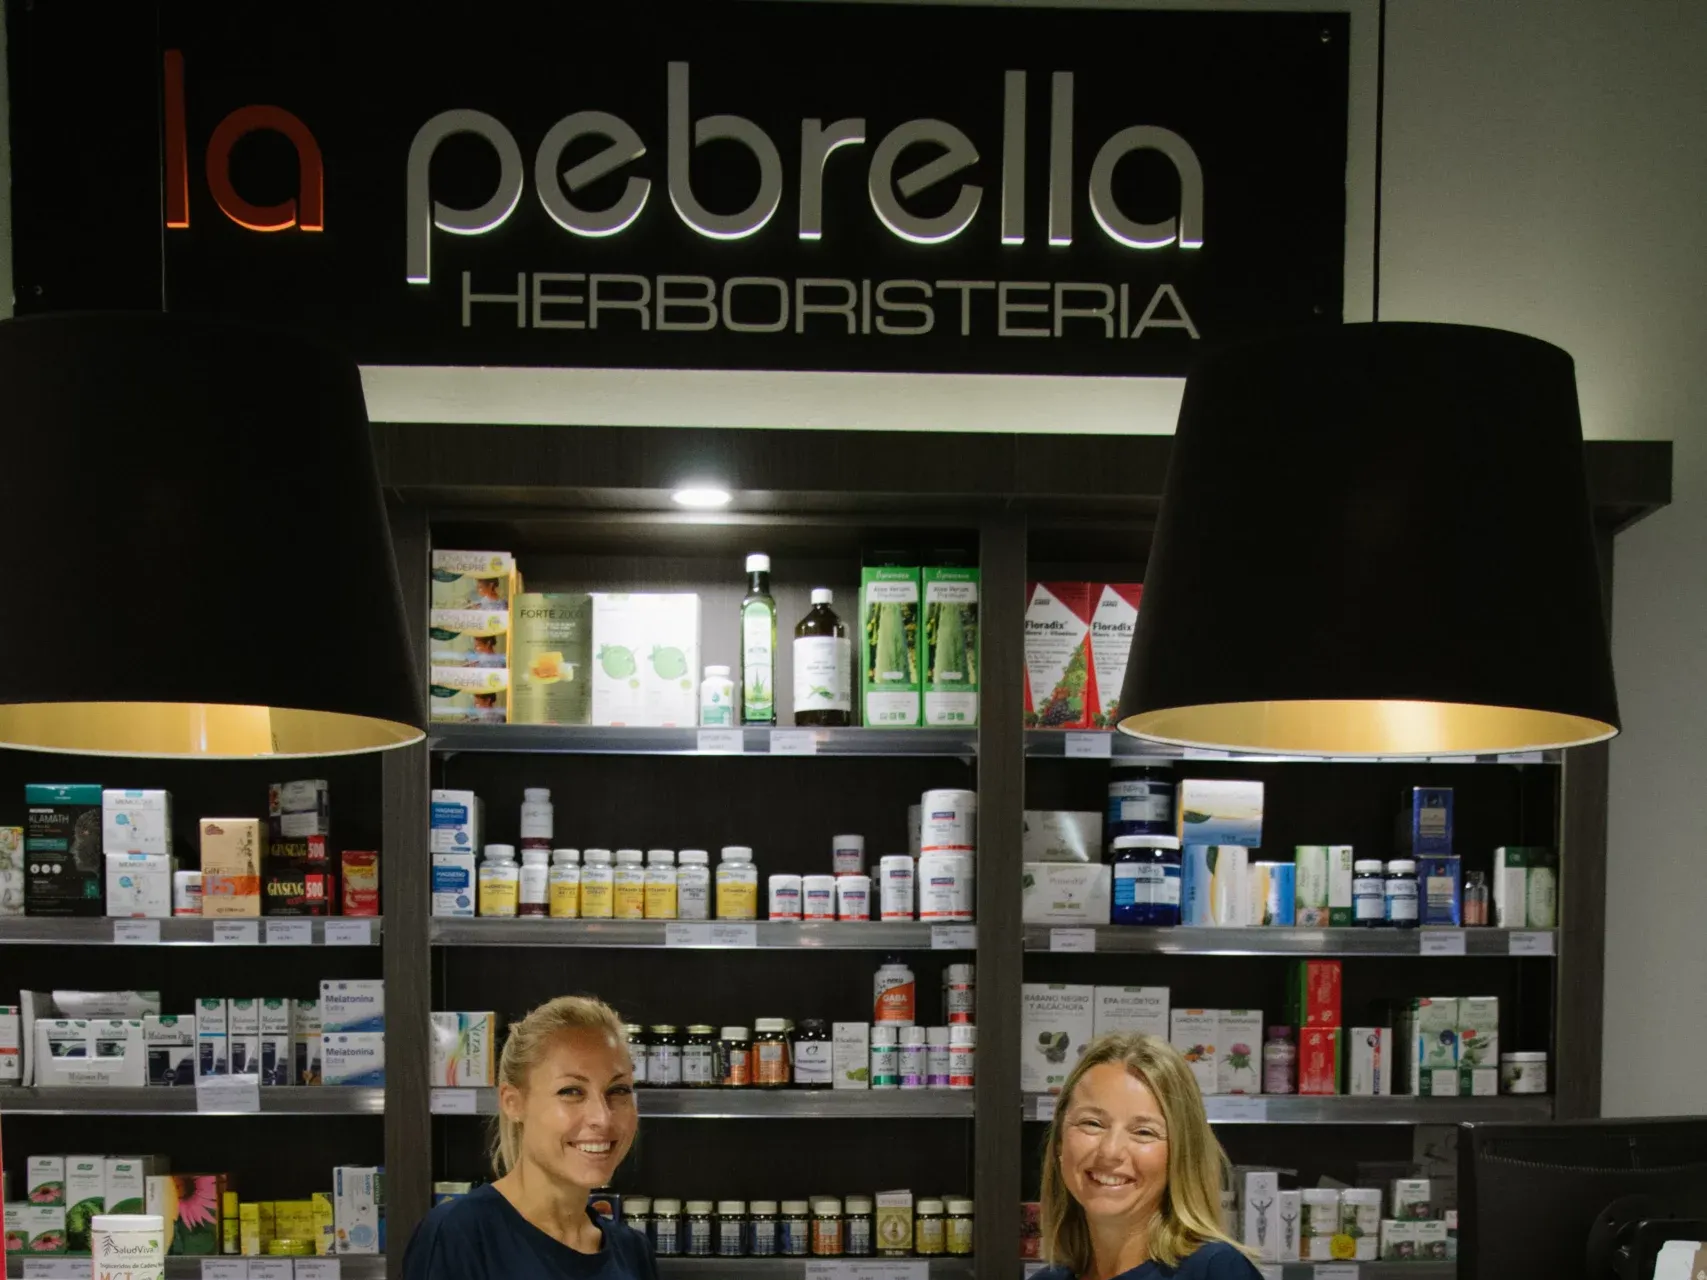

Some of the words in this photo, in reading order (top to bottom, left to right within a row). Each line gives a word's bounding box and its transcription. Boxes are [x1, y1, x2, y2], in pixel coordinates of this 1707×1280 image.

[163, 48, 325, 232] la
[405, 60, 1205, 285] pebrella
[460, 271, 1203, 340] HERBORISTERIA
[520, 609, 556, 618] FORTE
[1024, 620, 1065, 630] Floradix
[1093, 621, 1132, 631] Floradix
[28, 814, 69, 824] KLAMATH
[308, 843, 325, 859] 500
[267, 878, 304, 896] GINSENG
[306, 882, 324, 897] 500
[325, 995, 374, 1003] Melatonina
[325, 1048, 374, 1056] Melatonina
[113, 1246, 154, 1255] SaludViva
